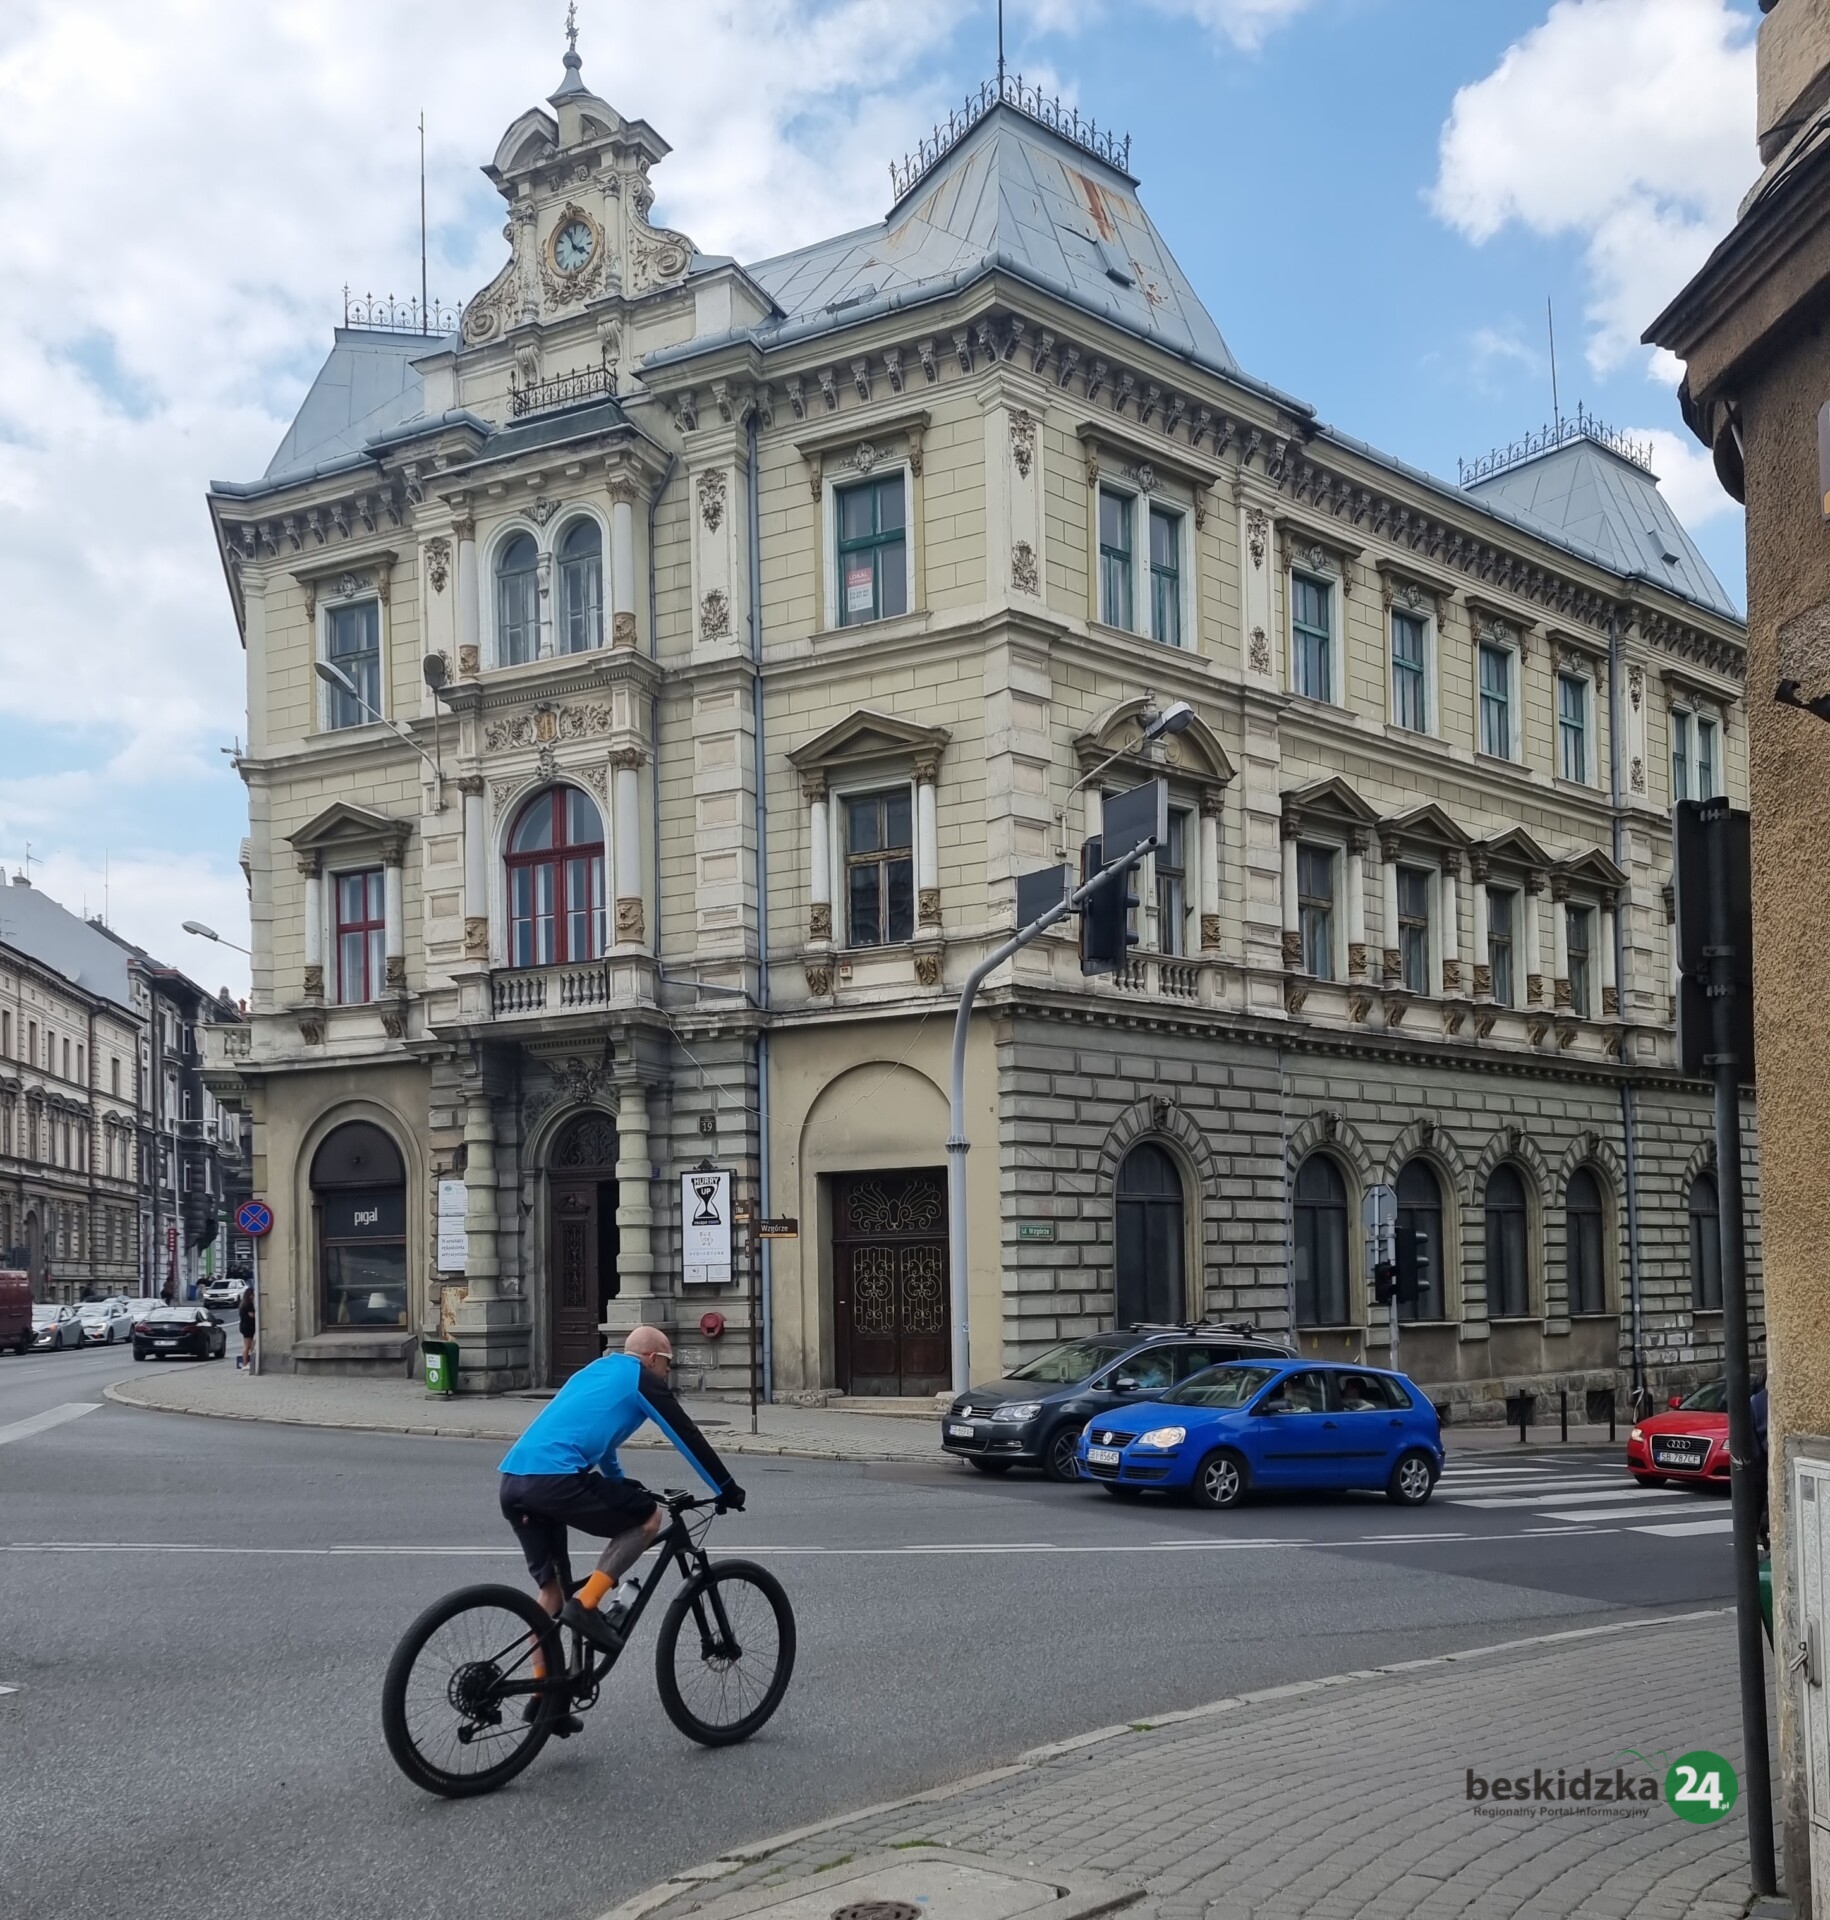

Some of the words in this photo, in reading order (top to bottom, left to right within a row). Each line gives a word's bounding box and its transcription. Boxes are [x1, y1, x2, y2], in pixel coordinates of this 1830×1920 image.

[702, 1122, 713, 1132] 19
[693, 1177, 719, 1185] HURRY
[354, 1207, 378, 1226] pigal
[761, 1224, 789, 1234] Wzgórze
[1661, 1452, 1671, 1461] SB
